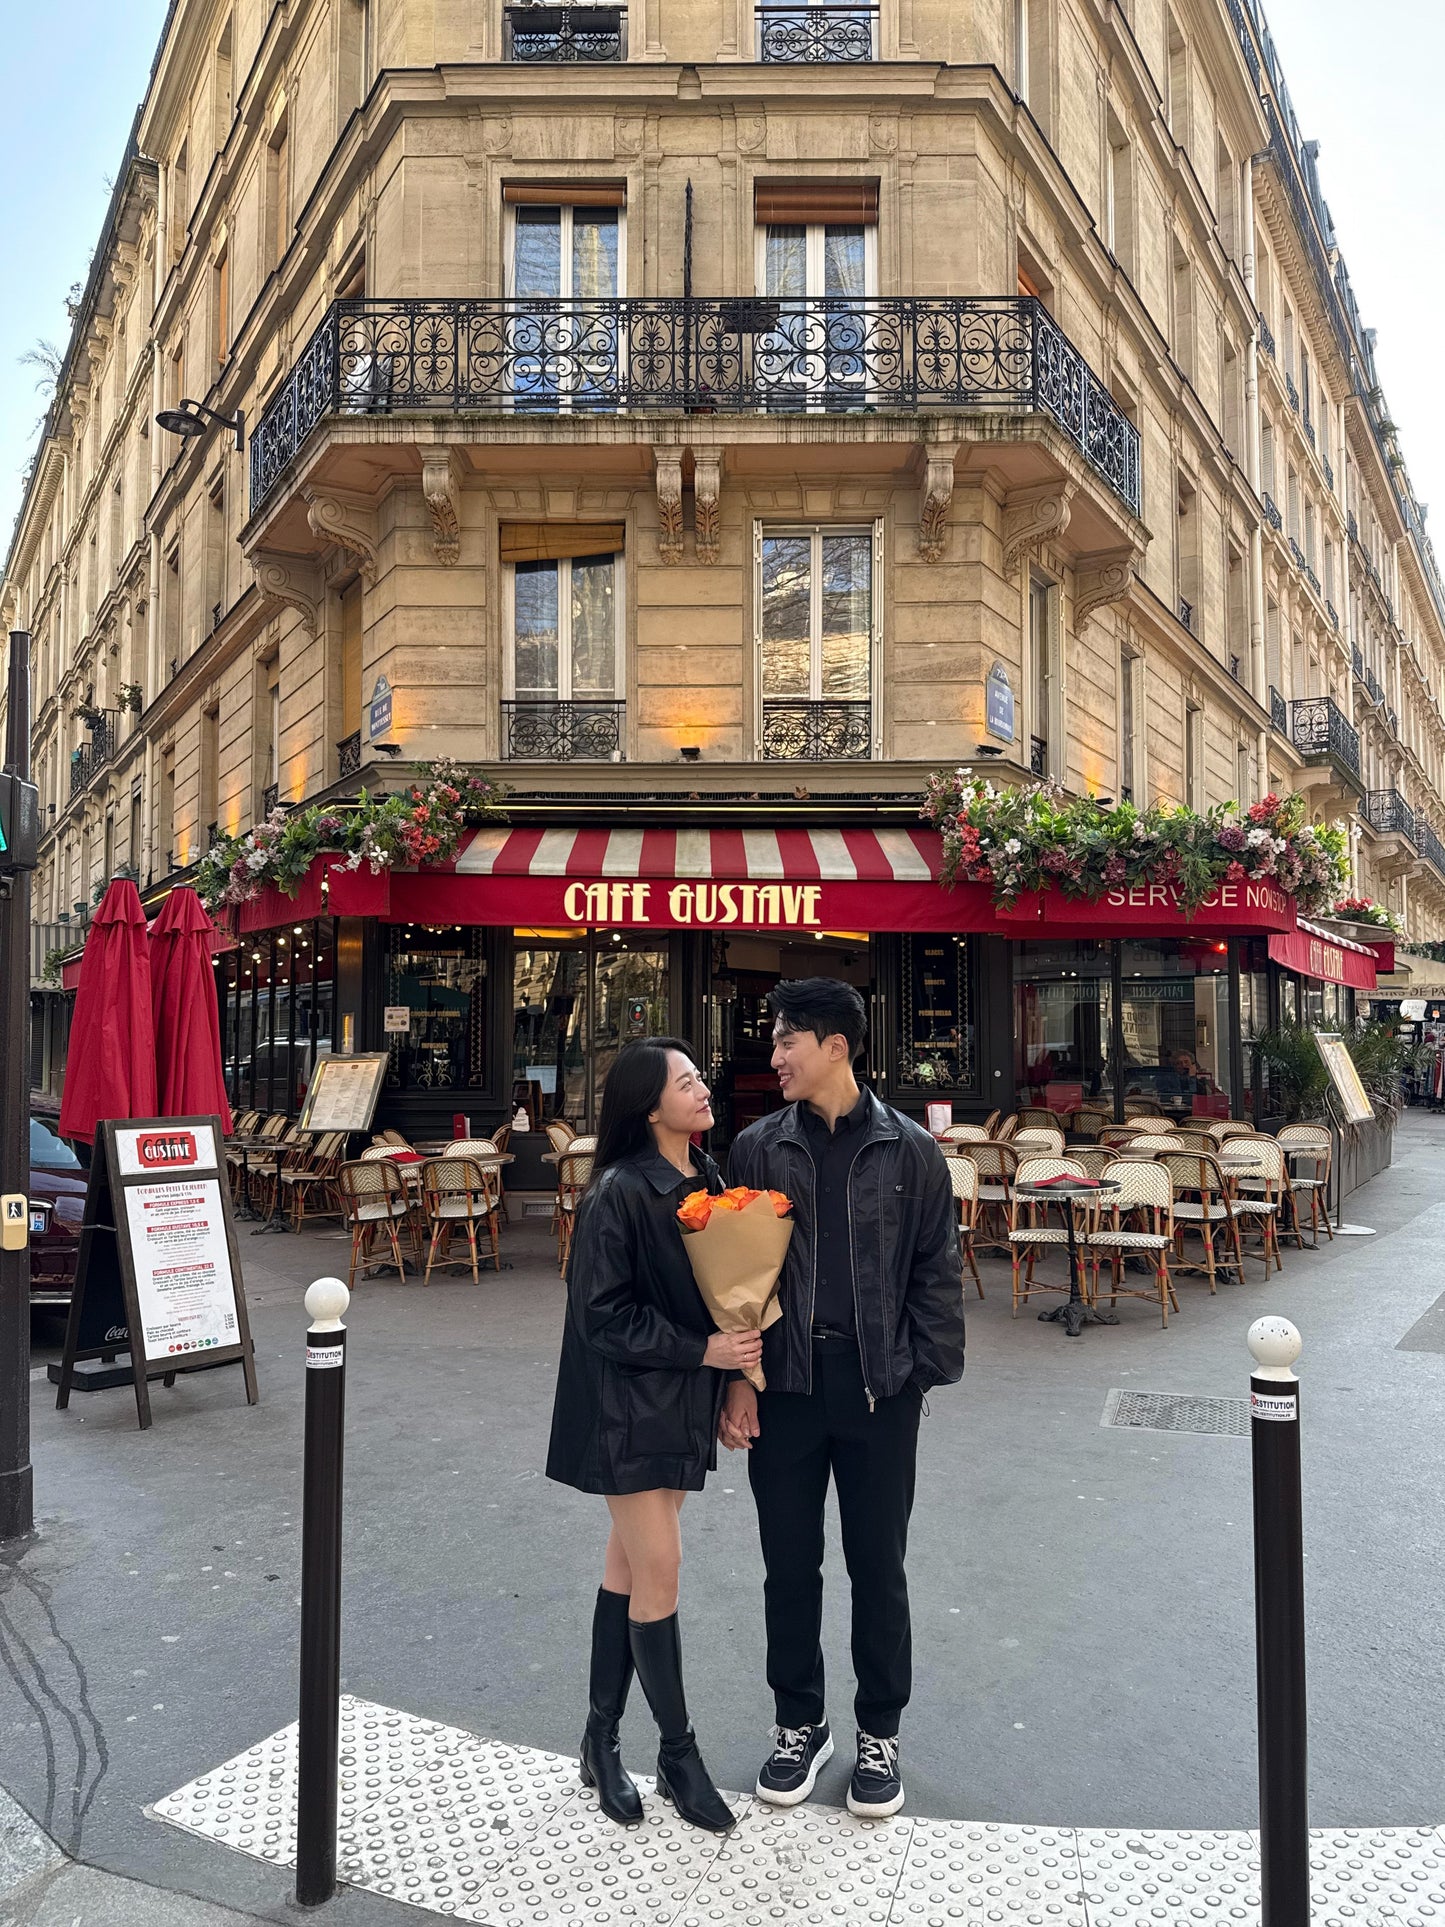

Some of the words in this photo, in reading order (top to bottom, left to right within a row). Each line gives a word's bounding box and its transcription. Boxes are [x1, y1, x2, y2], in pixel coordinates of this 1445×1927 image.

[564, 882, 651, 922] CAFE
[668, 883, 822, 924] GUSTAVE
[1107, 885, 1238, 906] SERVCE
[144, 1143, 191, 1159] GUSTAVE
